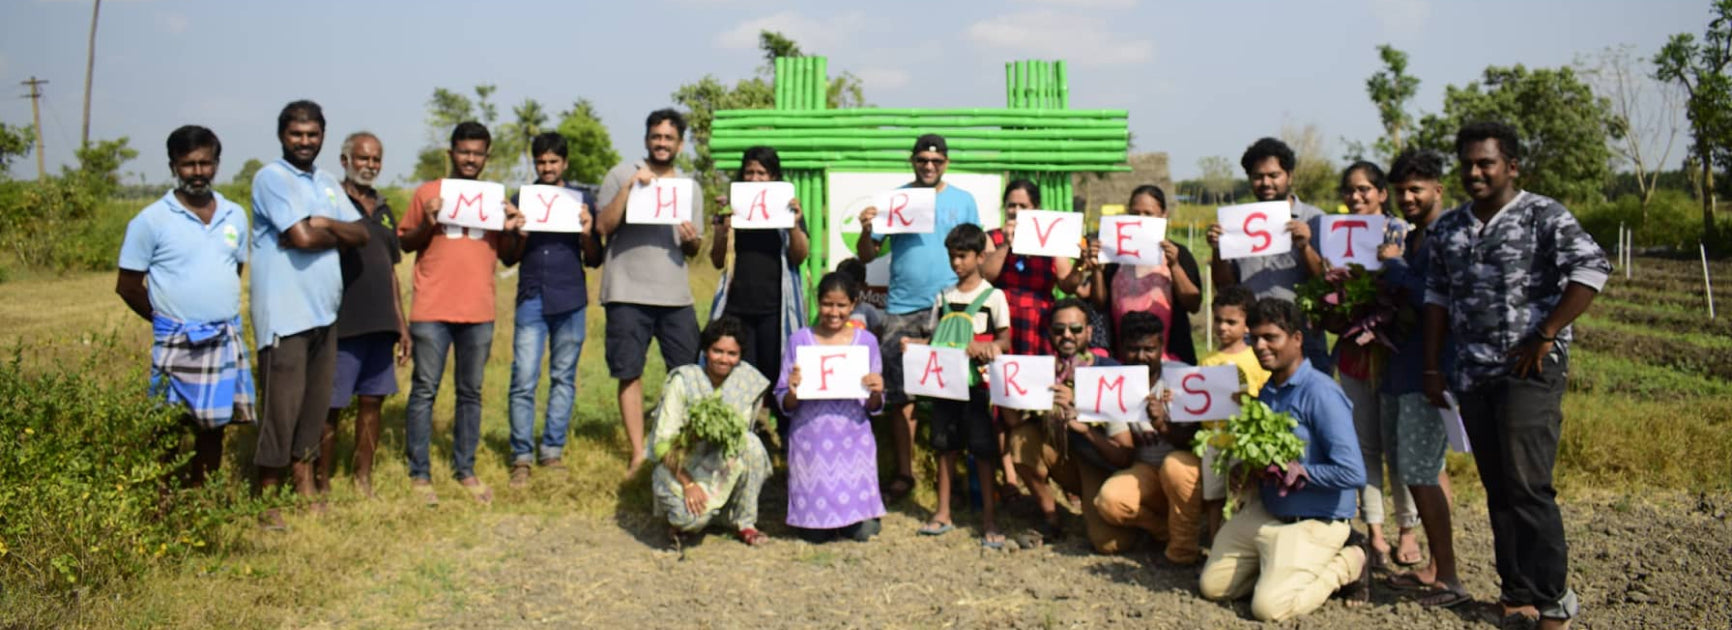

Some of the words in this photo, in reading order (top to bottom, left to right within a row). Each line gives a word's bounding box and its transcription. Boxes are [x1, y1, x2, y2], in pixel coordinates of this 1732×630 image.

[449, 192, 488, 222] M
[536, 193, 560, 224] Y
[656, 186, 678, 218] H
[747, 190, 771, 220] A
[887, 194, 913, 228] R
[1031, 216, 1063, 248] V
[1115, 221, 1143, 258] E
[1242, 212, 1273, 254] S
[1330, 219, 1367, 258] T
[819, 353, 847, 391] F
[920, 350, 945, 389] A
[1002, 360, 1028, 397] R
[1093, 374, 1127, 413] M
[1181, 372, 1212, 416] S
